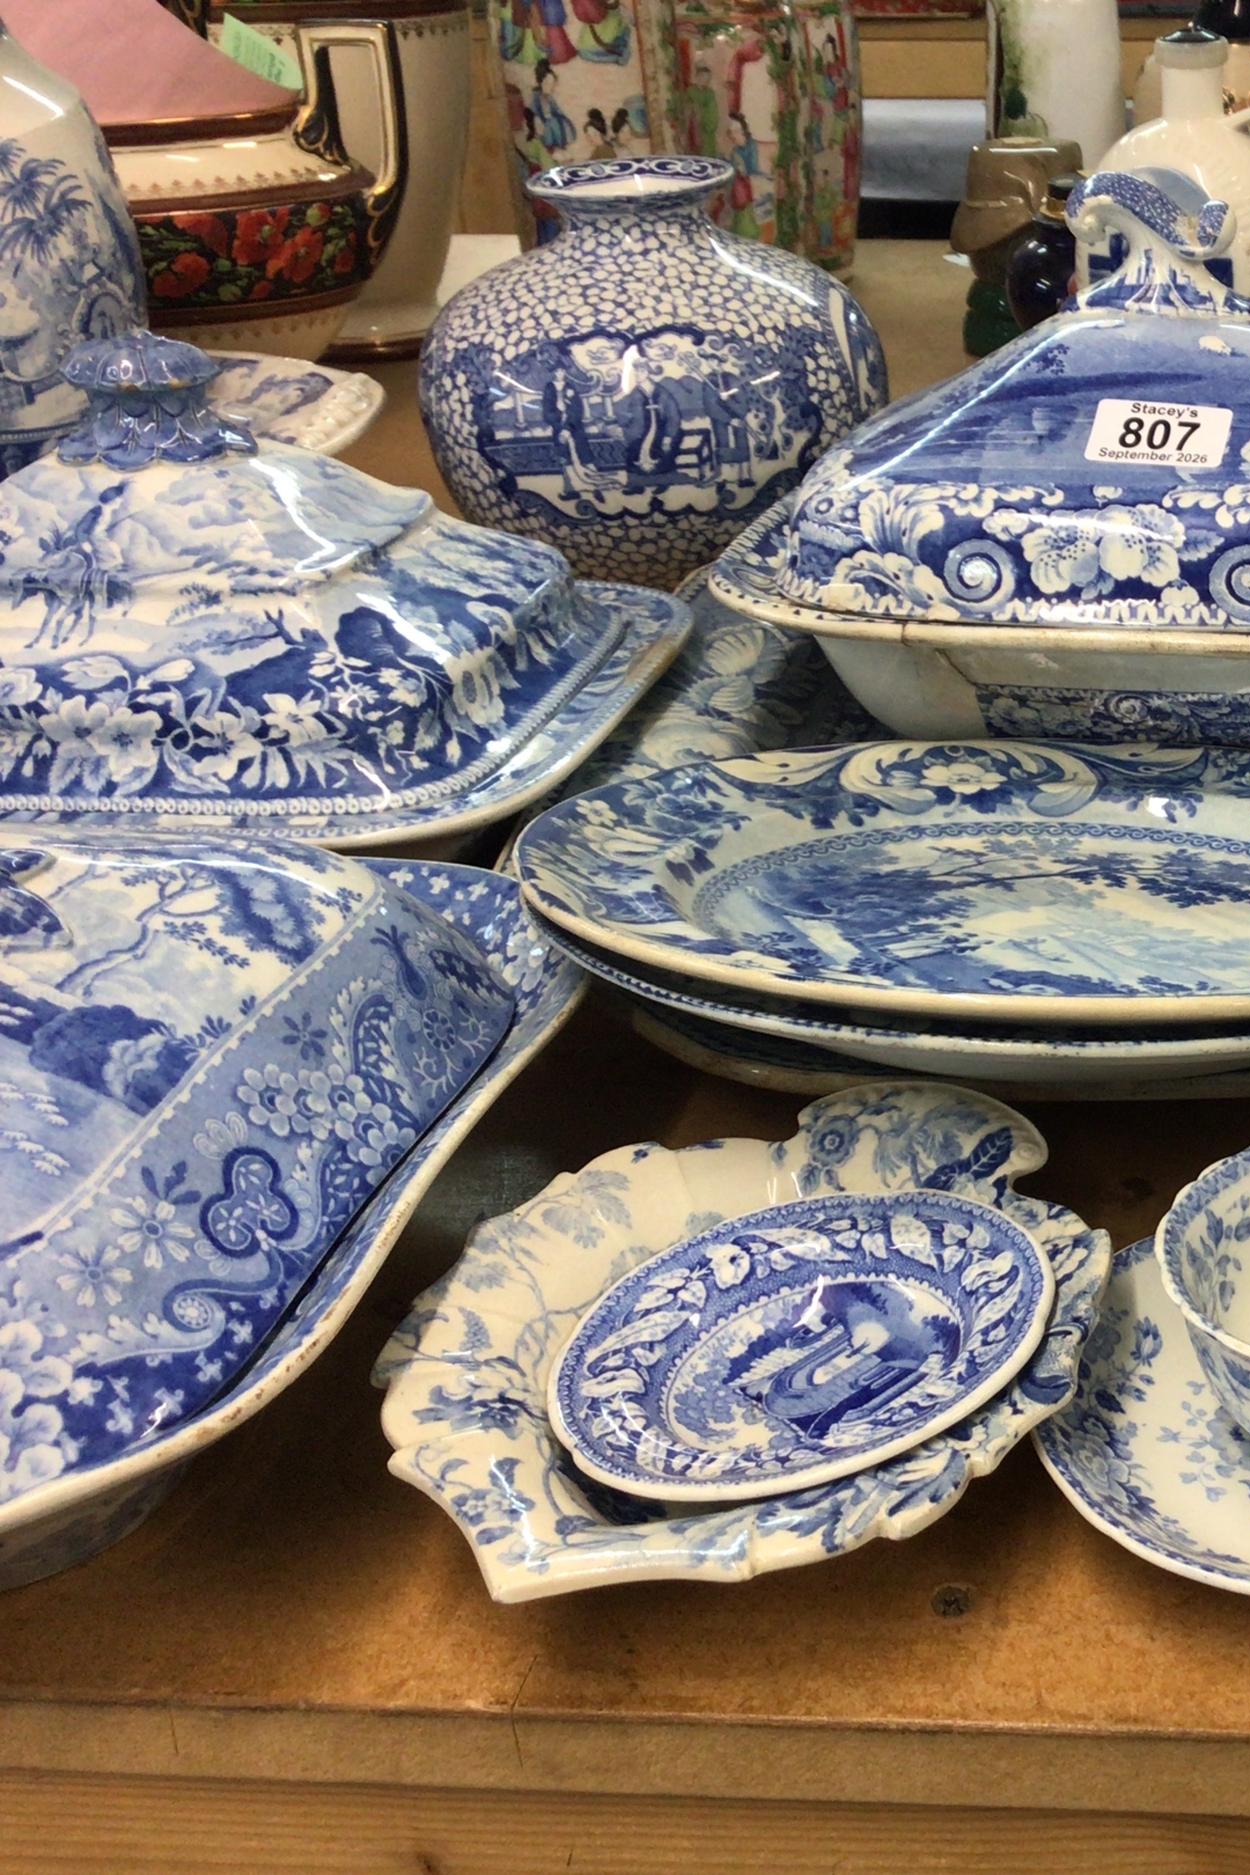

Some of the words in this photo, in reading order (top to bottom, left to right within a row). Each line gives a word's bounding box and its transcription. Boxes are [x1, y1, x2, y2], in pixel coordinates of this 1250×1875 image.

[1131, 402, 1198, 419] Stacey's
[1118, 417, 1201, 451] 807
[1098, 447, 1173, 461] September
[1176, 452, 1208, 464] 2026
